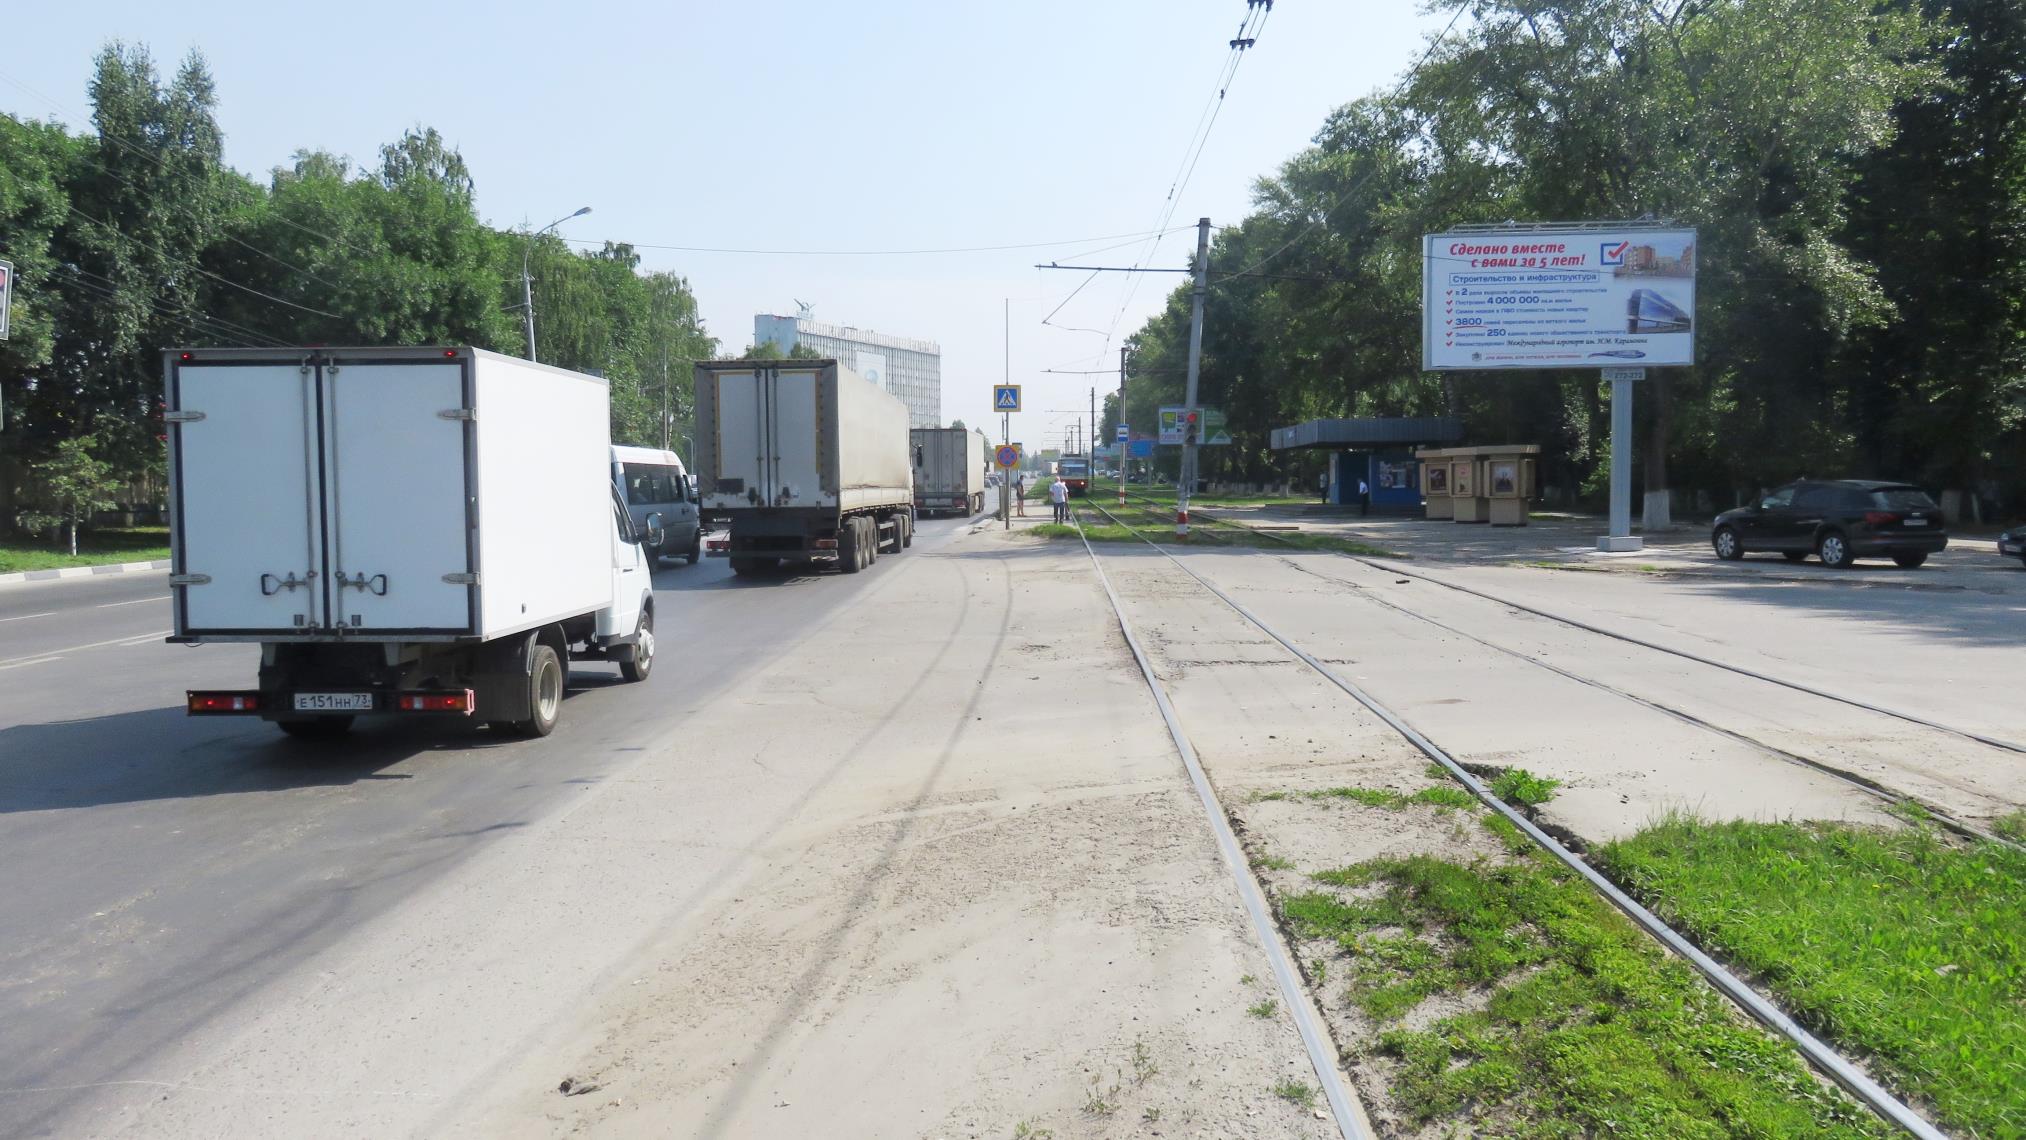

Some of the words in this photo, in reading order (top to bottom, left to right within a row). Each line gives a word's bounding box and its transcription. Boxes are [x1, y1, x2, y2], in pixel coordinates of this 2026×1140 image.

[1450, 243, 1508, 256] Сделано
[1511, 242, 1565, 254] вместе
[1471, 259, 1477, 268] с
[1481, 258, 1517, 268] вами
[1520, 257, 1536, 268] за
[1539, 257, 1547, 269] 5
[1551, 254, 1586, 267] лет!
[1453, 275, 1517, 284] Строительство
[1527, 273, 1597, 283] инфраструктура
[1461, 288, 1468, 296] 2
[1495, 296, 1516, 304] 000
[1518, 296, 1540, 304] 000
[1455, 318, 1482, 326] 3800
[1487, 329, 1506, 337] 250
[353, 694, 368, 705] 73
